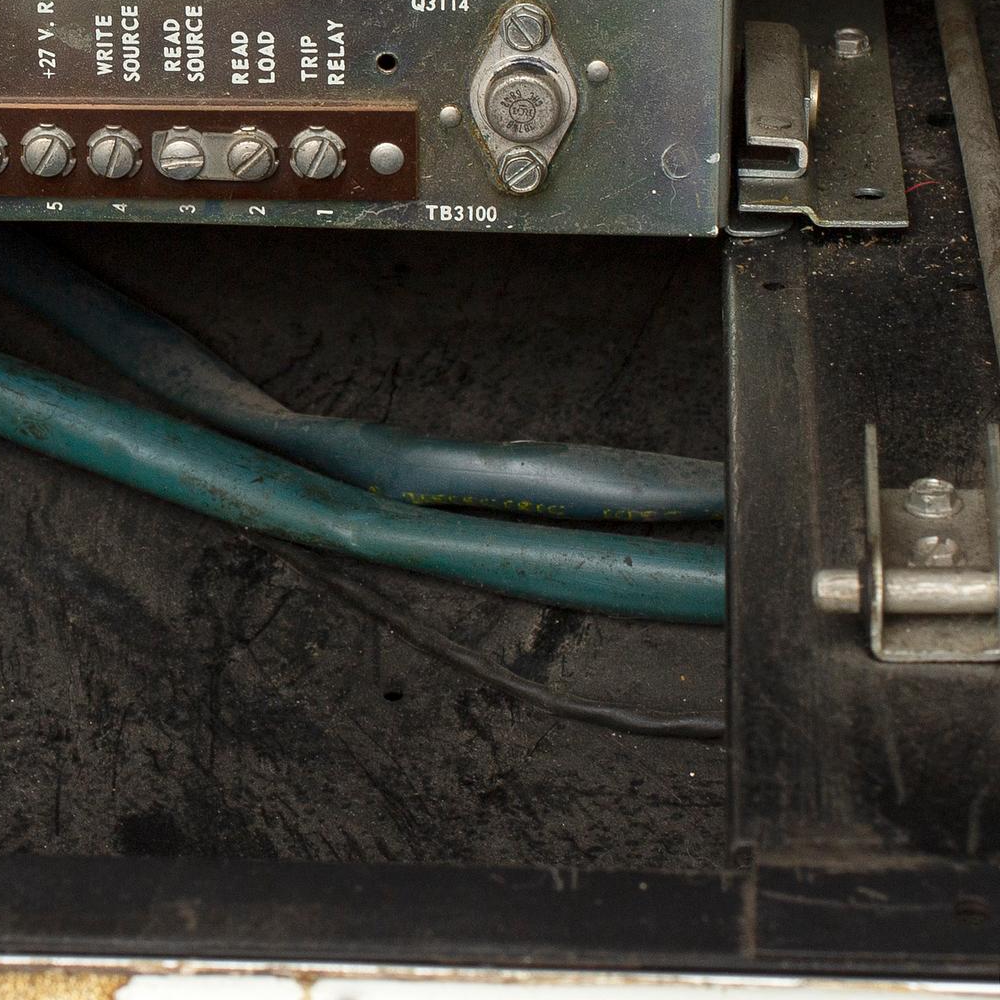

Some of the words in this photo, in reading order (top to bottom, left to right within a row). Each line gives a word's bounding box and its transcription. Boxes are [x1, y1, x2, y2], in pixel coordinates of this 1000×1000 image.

[37, 21, 55, 42] V.
[94, 14, 114, 78] WRITE
[120, 4, 141, 83] SOURCE
[162, 17, 182, 74] READ
[184, 4, 205, 84] SOURCE
[230, 31, 250, 86] READ
[256, 30, 276, 85] LOAD
[299, 35, 319, 83] TRIP
[326, 18, 346, 86] RELAY
[37, 48, 57, 80] +27
[46, 200, 64, 213] 5
[111, 202, 128, 215] 4
[178, 204, 197, 216] 3
[249, 205, 266, 218] 2
[316, 208, 334, 217] 1
[425, 204, 498, 223] TB3100
